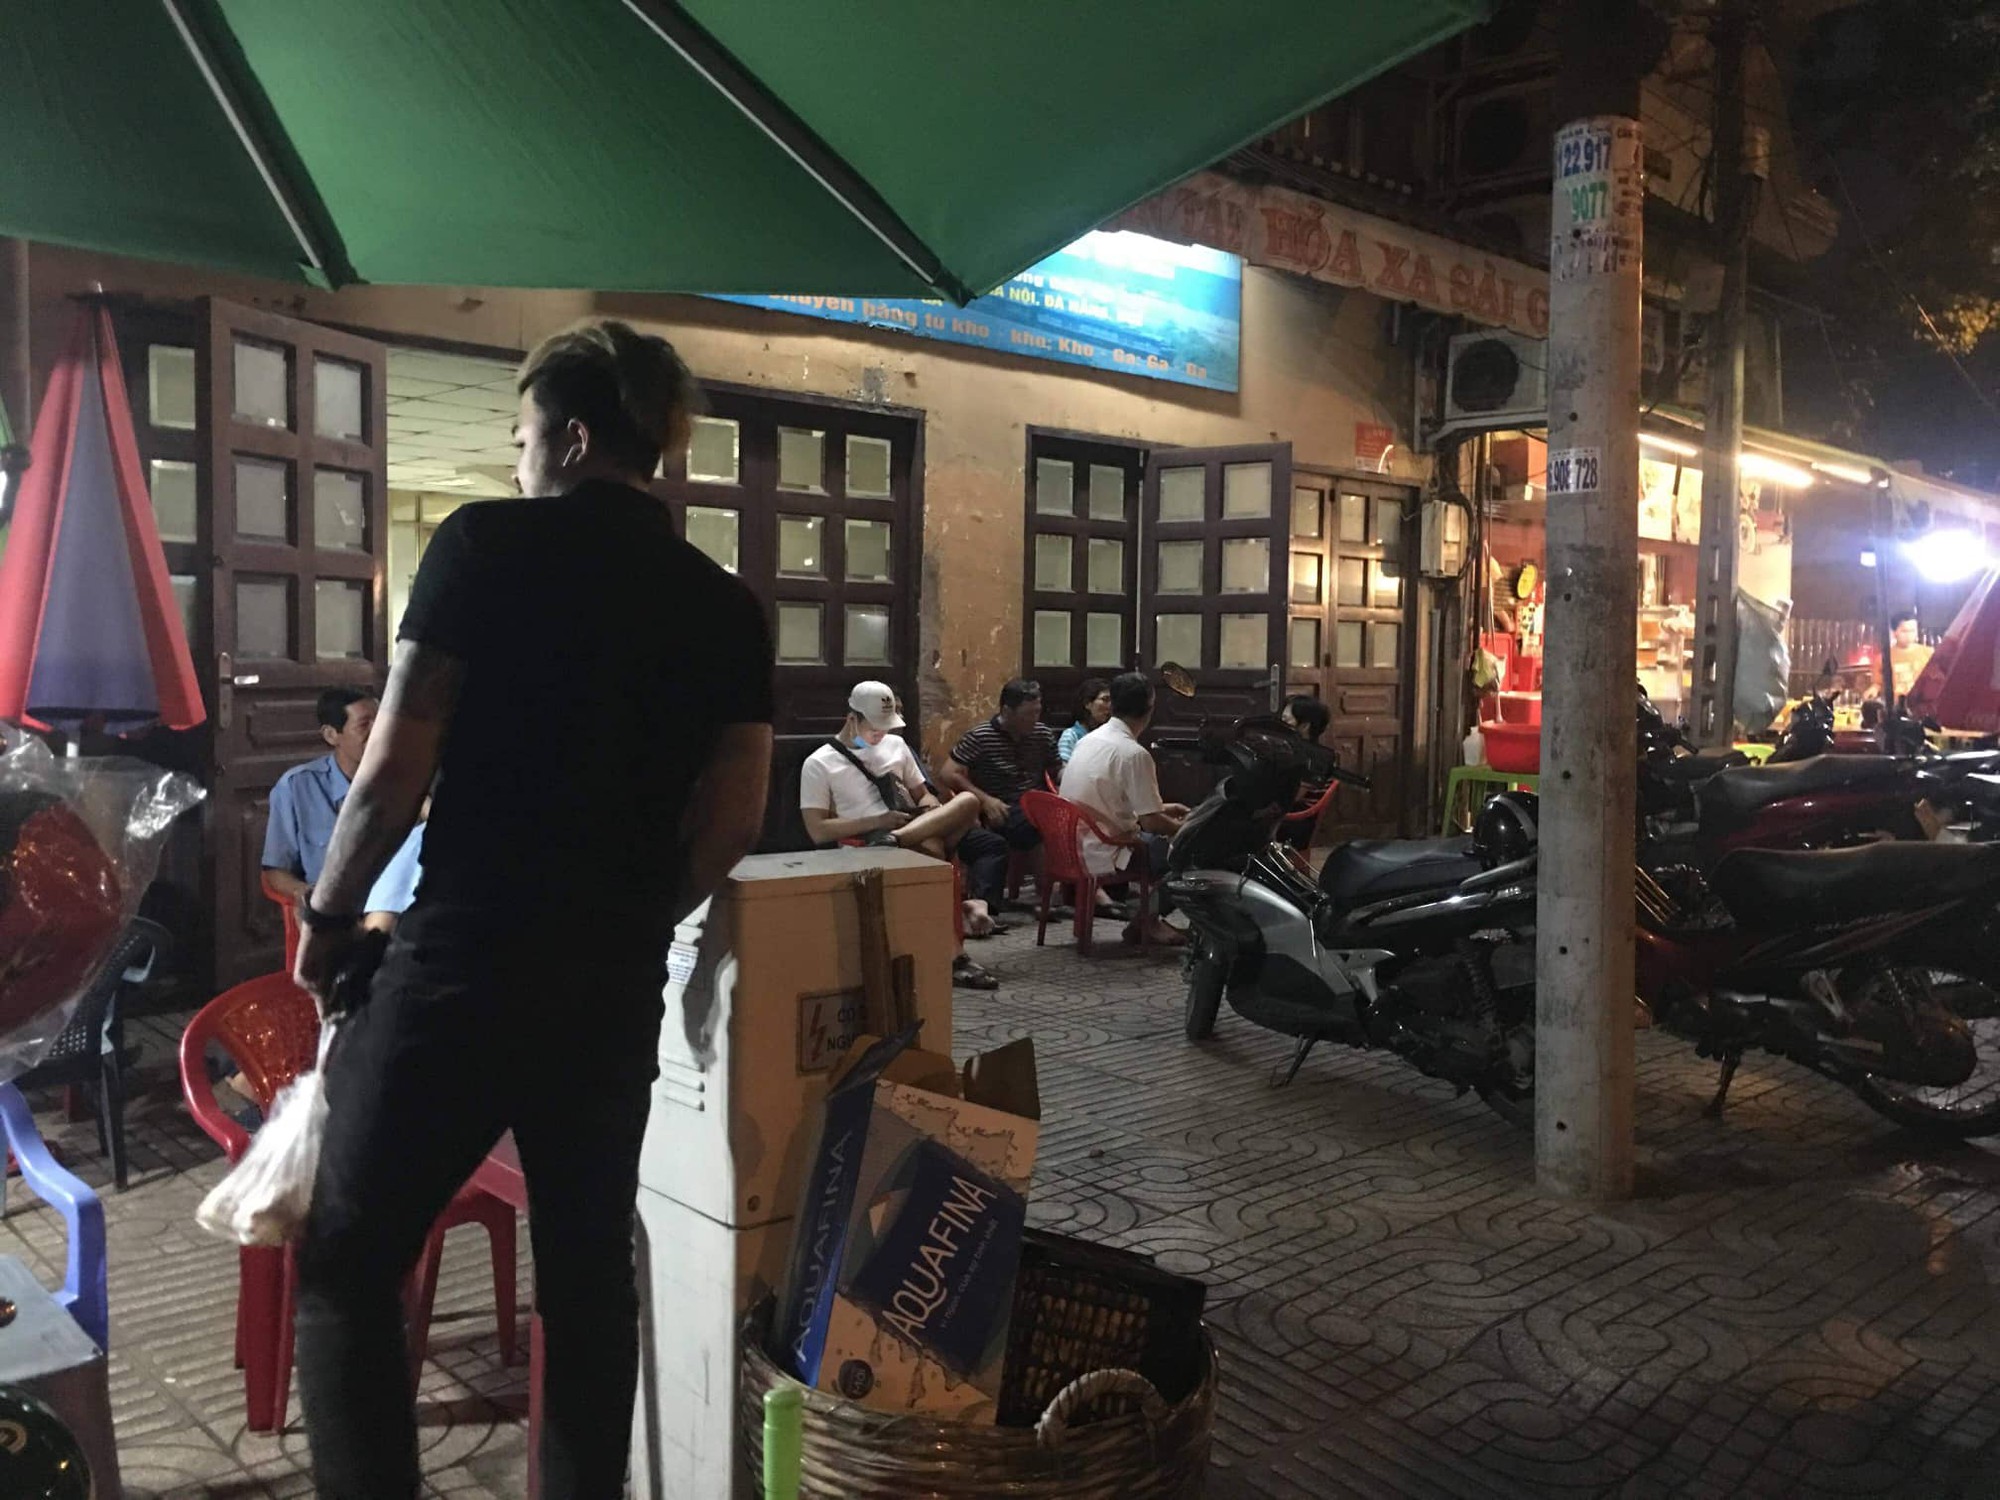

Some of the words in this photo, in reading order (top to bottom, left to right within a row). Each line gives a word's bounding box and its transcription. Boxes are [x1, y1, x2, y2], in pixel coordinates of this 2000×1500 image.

[1373, 241, 1439, 302] XA
[790, 1132, 852, 1362] AQUAFINA
[881, 1175, 998, 1346] AQUAFINA
